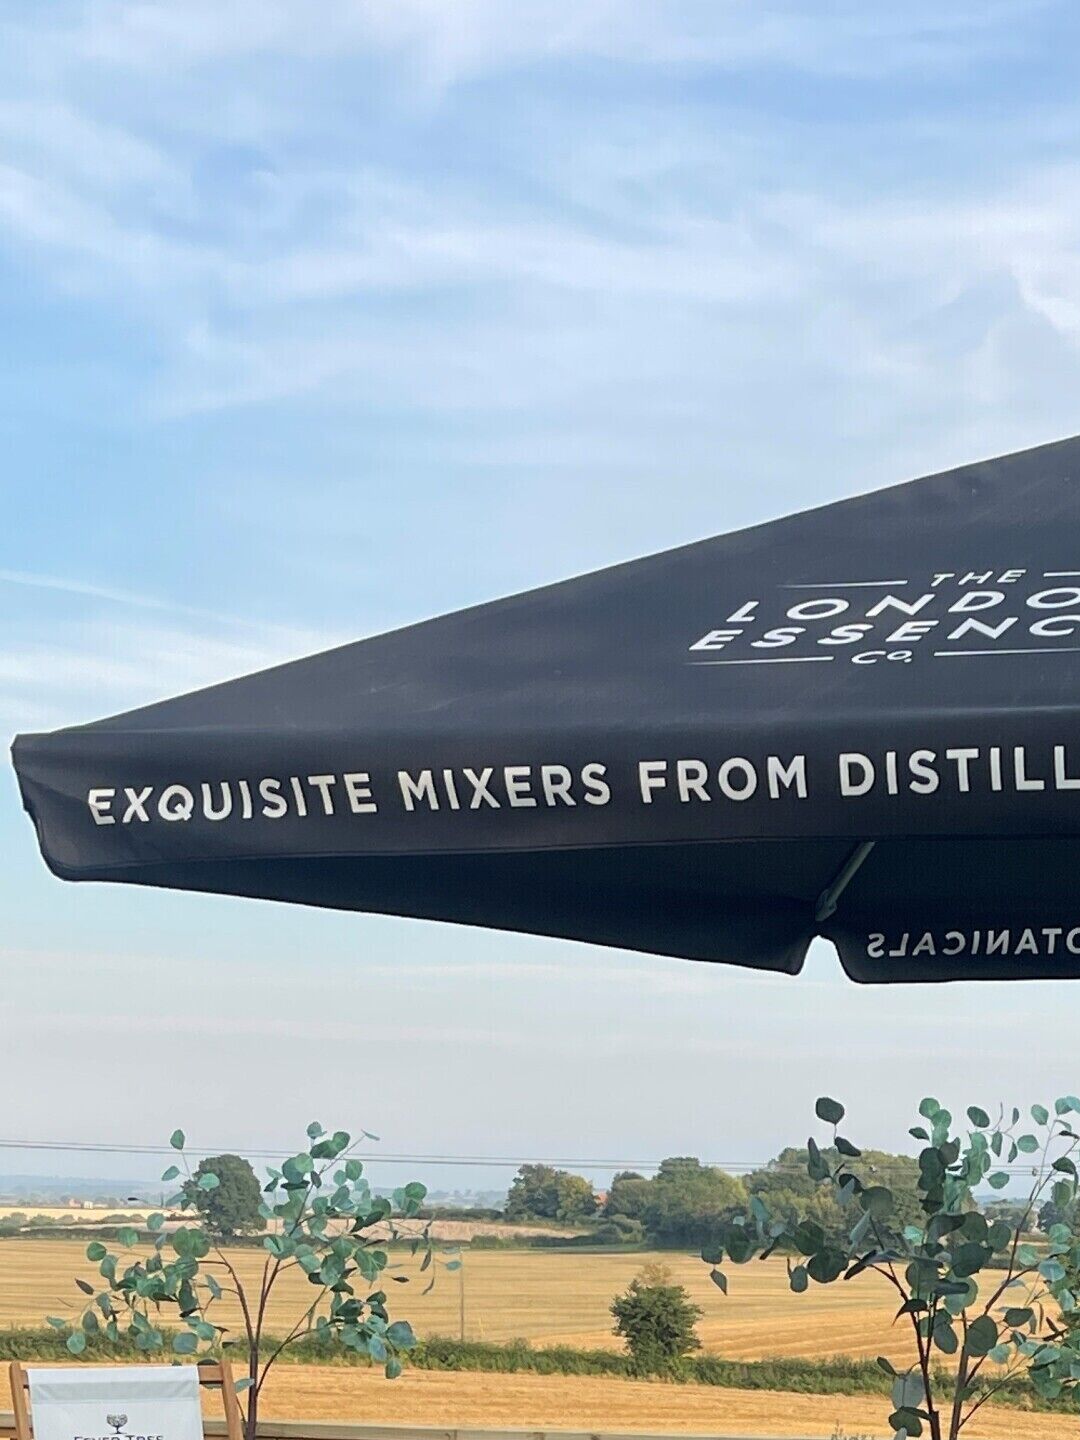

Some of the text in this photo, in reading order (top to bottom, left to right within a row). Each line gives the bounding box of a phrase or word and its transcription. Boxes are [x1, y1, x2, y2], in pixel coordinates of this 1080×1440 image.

[930, 569, 1027, 588] THE
[87, 772, 378, 827] EXQUISITE
[397, 763, 611, 813] MIXERS
[638, 755, 807, 803] FROM
